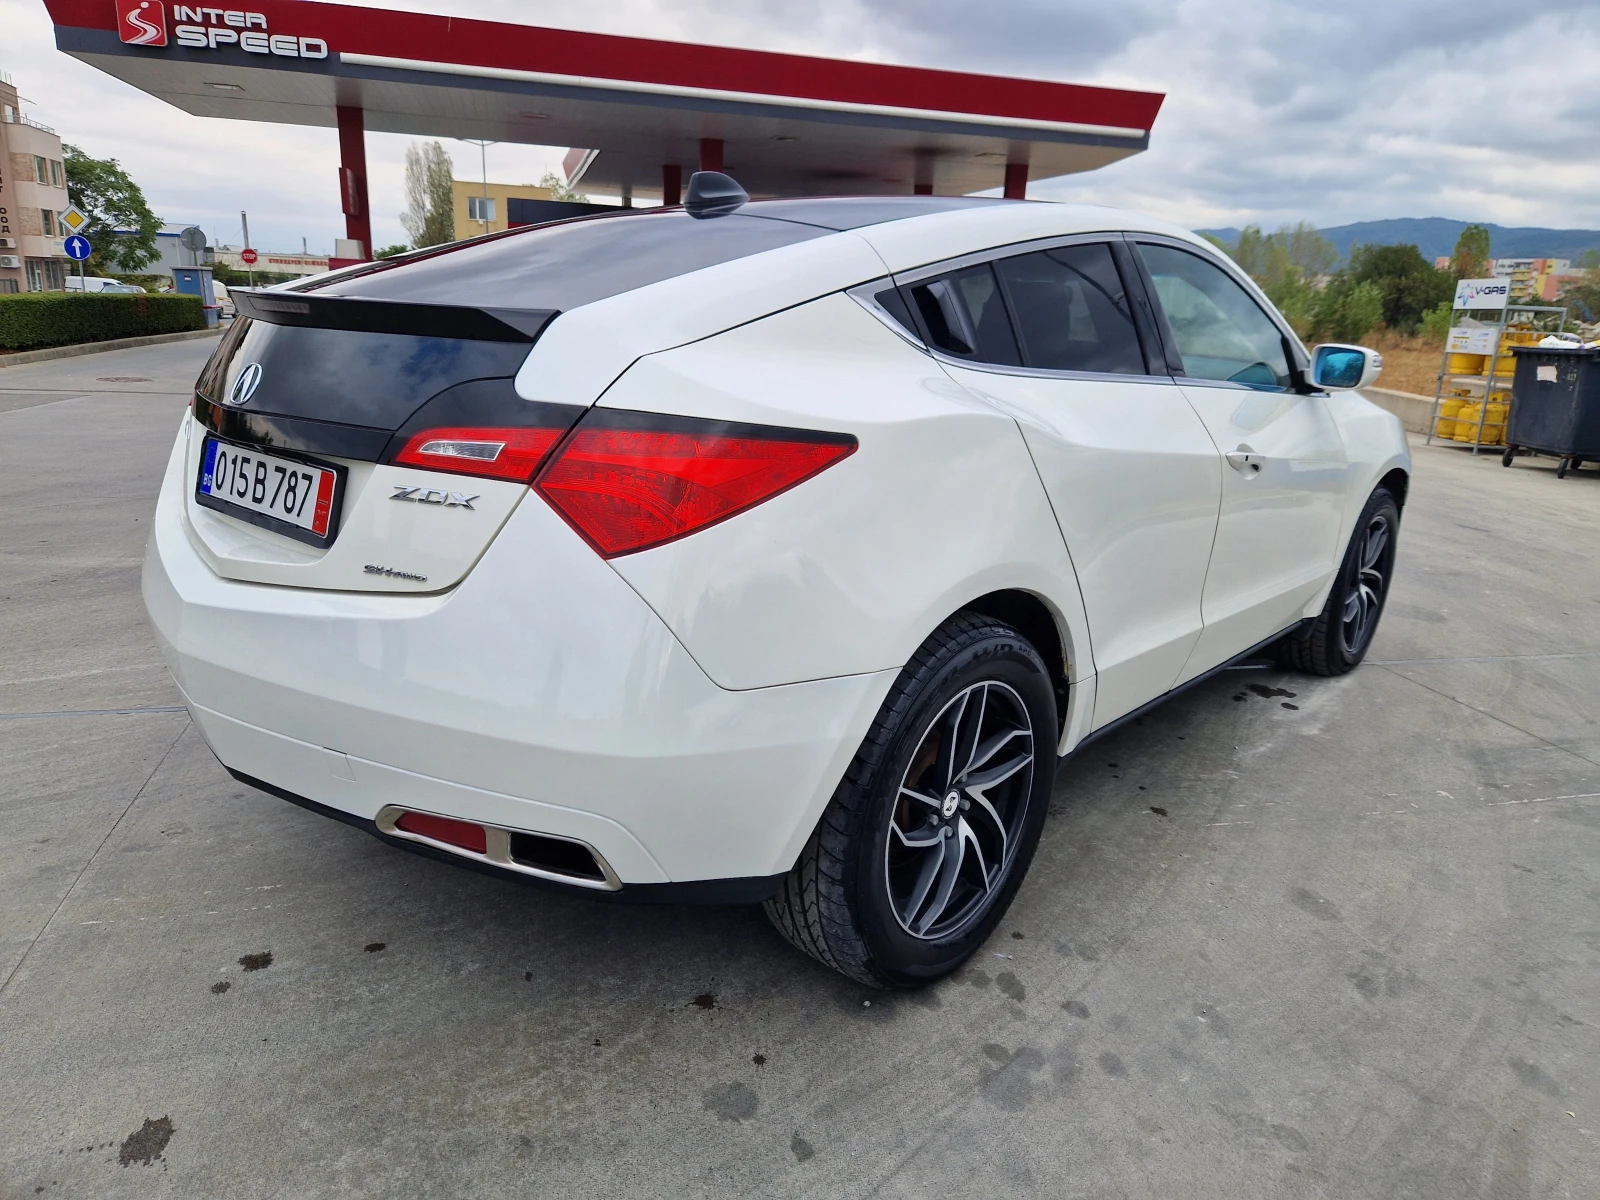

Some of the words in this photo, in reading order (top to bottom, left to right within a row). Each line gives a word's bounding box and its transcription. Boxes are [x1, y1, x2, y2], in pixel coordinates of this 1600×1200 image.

[173, 4, 268, 29] INTER
[175, 25, 328, 59] SPEED
[1475, 286, 1507, 296] V-GAS
[203, 473, 212, 487] BG
[389, 484, 480, 511] ZDX
